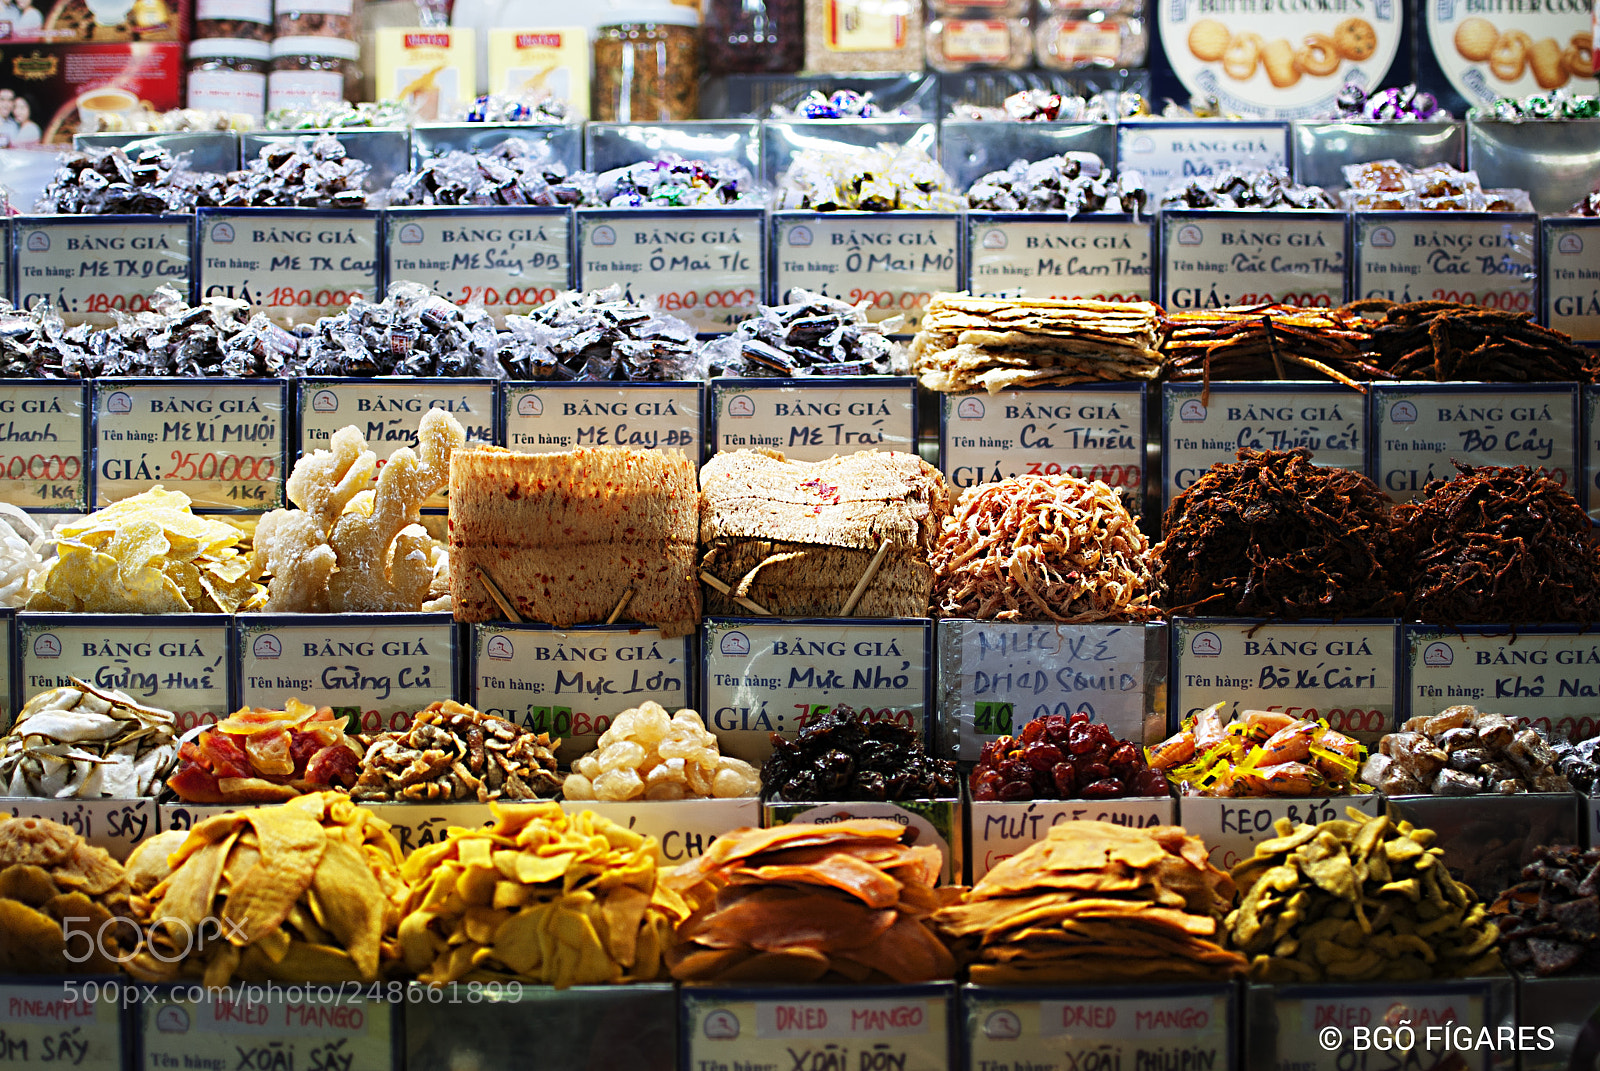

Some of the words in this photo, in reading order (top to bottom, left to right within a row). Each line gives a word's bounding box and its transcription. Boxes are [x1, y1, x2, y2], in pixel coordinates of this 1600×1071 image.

[67, 235, 125, 250] BẢNG
[131, 234, 170, 250] GIÁ
[252, 227, 312, 244] BẢNG
[317, 228, 358, 244] GIÁ
[442, 227, 502, 243] BẢNG
[508, 226, 549, 242] GIÁ
[634, 229, 695, 245] BẢNG
[701, 228, 742, 245] GIÁ
[831, 230, 892, 246] BẢNG
[898, 230, 938, 246] GIÁ
[1026, 233, 1087, 249] BẢNG
[1093, 233, 1132, 249] GIÁ
[1221, 230, 1282, 246] BẢNG
[1287, 231, 1326, 247] GIÁ
[1414, 231, 1473, 248] BẢNG
[1479, 232, 1517, 248] GIÁ
[22, 265, 43, 277] Tên
[46, 264, 75, 279] hàng:
[156, 259, 189, 280] Cay
[206, 257, 226, 269] Tên
[229, 257, 260, 271] hàng:
[340, 257, 378, 277] Cay
[395, 258, 416, 270] Tên
[419, 258, 449, 271] hàng:
[588, 261, 609, 272] Tên
[611, 261, 642, 273] hàng:
[650, 247, 665, 272] Ô
[670, 254, 711, 271] Mai
[784, 261, 805, 272] Tên
[808, 261, 839, 273] hàng:
[846, 246, 862, 273] Ô
[867, 253, 914, 273] Mai
[1067, 257, 1110, 276] Cam
[1271, 256, 1310, 274] Cam
[1172, 282, 1231, 308] GIÁ:
[21, 397, 62, 413] GIÁ
[150, 397, 213, 413] BẢNG
[219, 397, 261, 413] GIÁ
[357, 395, 421, 412] BẢNG
[429, 396, 472, 413] GIÁ
[563, 399, 628, 416] BẢNG
[635, 399, 679, 416] GIÁ
[775, 400, 841, 416] BẢNG
[848, 399, 892, 416] GIÁ
[1005, 402, 1072, 419] BẢNG
[1078, 403, 1122, 420] GIÁ
[1227, 404, 1294, 421] BẢNG
[1301, 404, 1344, 421] GIÁ
[1437, 404, 1504, 422] BẢNG
[1511, 404, 1553, 421] GIÁ
[102, 429, 124, 441] Tên
[126, 429, 158, 443] hàng:
[307, 428, 329, 440] Tên
[512, 433, 535, 445] Tên
[538, 433, 571, 447] hàng:
[614, 423, 658, 450] Cay
[723, 434, 747, 446] Tên
[750, 434, 784, 448] hàng:
[828, 419, 885, 446] Trái
[952, 436, 975, 448] Tên
[979, 436, 1013, 450] hàng:
[1020, 423, 1058, 449] Cá
[1174, 438, 1198, 450] Tên
[1201, 438, 1236, 452] hàng:
[1237, 426, 1266, 449] Cá
[1385, 439, 1408, 451] Tên
[1412, 439, 1447, 453] hàng:
[1459, 425, 1499, 452] Bò
[1505, 427, 1554, 460] Cây
[102, 453, 161, 481] GIÁ:
[82, 639, 151, 657] BẢNG
[159, 638, 205, 657] GIÁ
[302, 638, 375, 657] BẢNG
[381, 637, 429, 657] GIÁ
[534, 643, 608, 662] BẢNG
[615, 642, 664, 661] GIÁ
[772, 637, 846, 656] BẢNG
[853, 638, 903, 657] GIÁ
[1243, 637, 1318, 656] BẢNG
[1325, 637, 1373, 656] GIÁ
[1475, 646, 1549, 665] BẢNG
[29, 675, 53, 688] Tên
[95, 658, 159, 697] Gừng
[162, 655, 223, 690] Huế
[248, 676, 273, 689] Tên
[276, 676, 313, 692] hàng:
[321, 665, 391, 700] Gừng
[398, 665, 431, 689] Củ
[482, 676, 506, 690] Tên
[509, 678, 545, 694] hàng:
[555, 669, 618, 701] Mực
[622, 657, 682, 695] Lớn
[714, 674, 740, 687] Tên
[745, 674, 781, 689] hàng:
[788, 667, 845, 695] Mực
[853, 660, 911, 690] Nhỏ
[1185, 675, 1211, 688] Tên
[1215, 675, 1253, 690] hàng:
[1258, 665, 1290, 689] Bò
[1417, 685, 1442, 697] Tên
[1447, 685, 1485, 700] hàng:
[1495, 675, 1545, 699] Khô
[714, 701, 785, 732] GIÁ:
[107, 801, 148, 844] SẤY
[1221, 804, 1273, 842] KẸO
[286, 1003, 364, 1031] MANGO
[776, 1005, 828, 1031] DRIED
[851, 1006, 923, 1031] MANGO
[1062, 1005, 1118, 1030] DRIED
[1136, 1007, 1209, 1030] MANGO
[41, 1026, 88, 1066] SẤY
[152, 1052, 180, 1067] Tên
[235, 1043, 296, 1071] XOÀI
